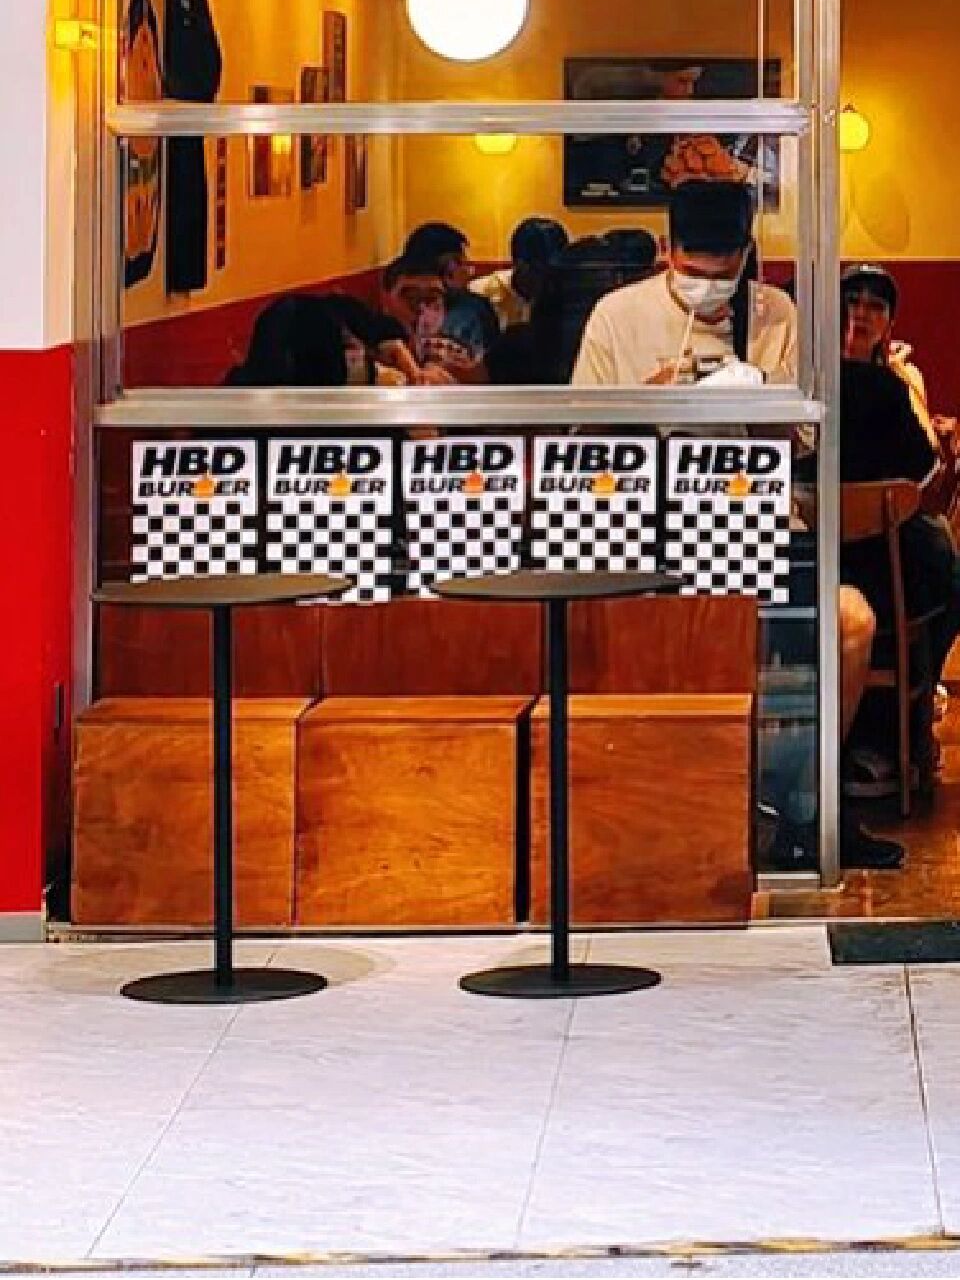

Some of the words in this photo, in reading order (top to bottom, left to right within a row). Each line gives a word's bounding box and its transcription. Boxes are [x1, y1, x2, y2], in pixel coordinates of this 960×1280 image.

[141, 445, 246, 477] HBD
[276, 444, 382, 475] HBD
[412, 444, 516, 473] HBD
[542, 443, 647, 473] HBD
[677, 444, 782, 474] HBD
[138, 477, 250, 497] BURER
[275, 477, 386, 497] BURER
[410, 474, 518, 494] BURER
[540, 475, 650, 494] BURER
[674, 477, 784, 496] BURER
